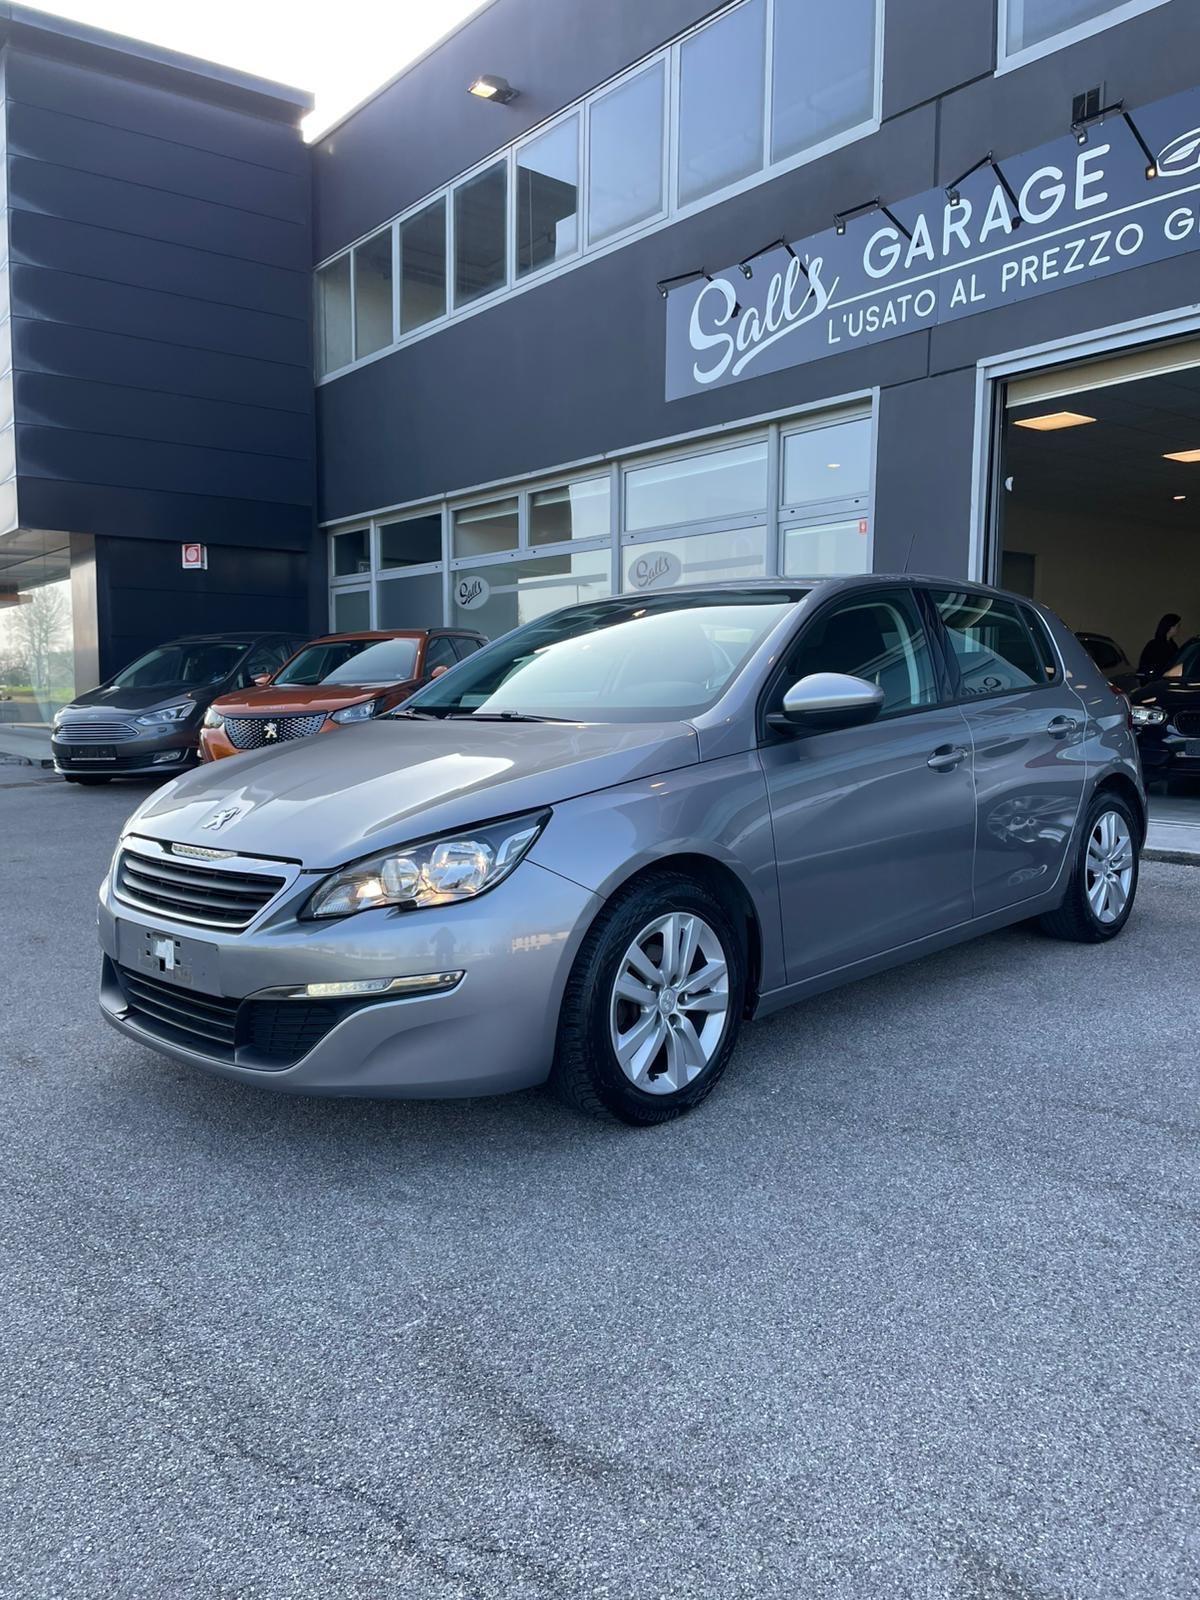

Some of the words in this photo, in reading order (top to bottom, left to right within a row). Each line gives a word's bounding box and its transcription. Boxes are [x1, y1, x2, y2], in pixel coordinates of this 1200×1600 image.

[689, 253, 840, 384] Sall's
[863, 143, 1111, 279] GARAGE
[827, 288, 936, 344] L'USATO
[949, 273, 986, 308] AL
[1001, 222, 1144, 293] PREZZO
[1164, 207, 1200, 241] G
